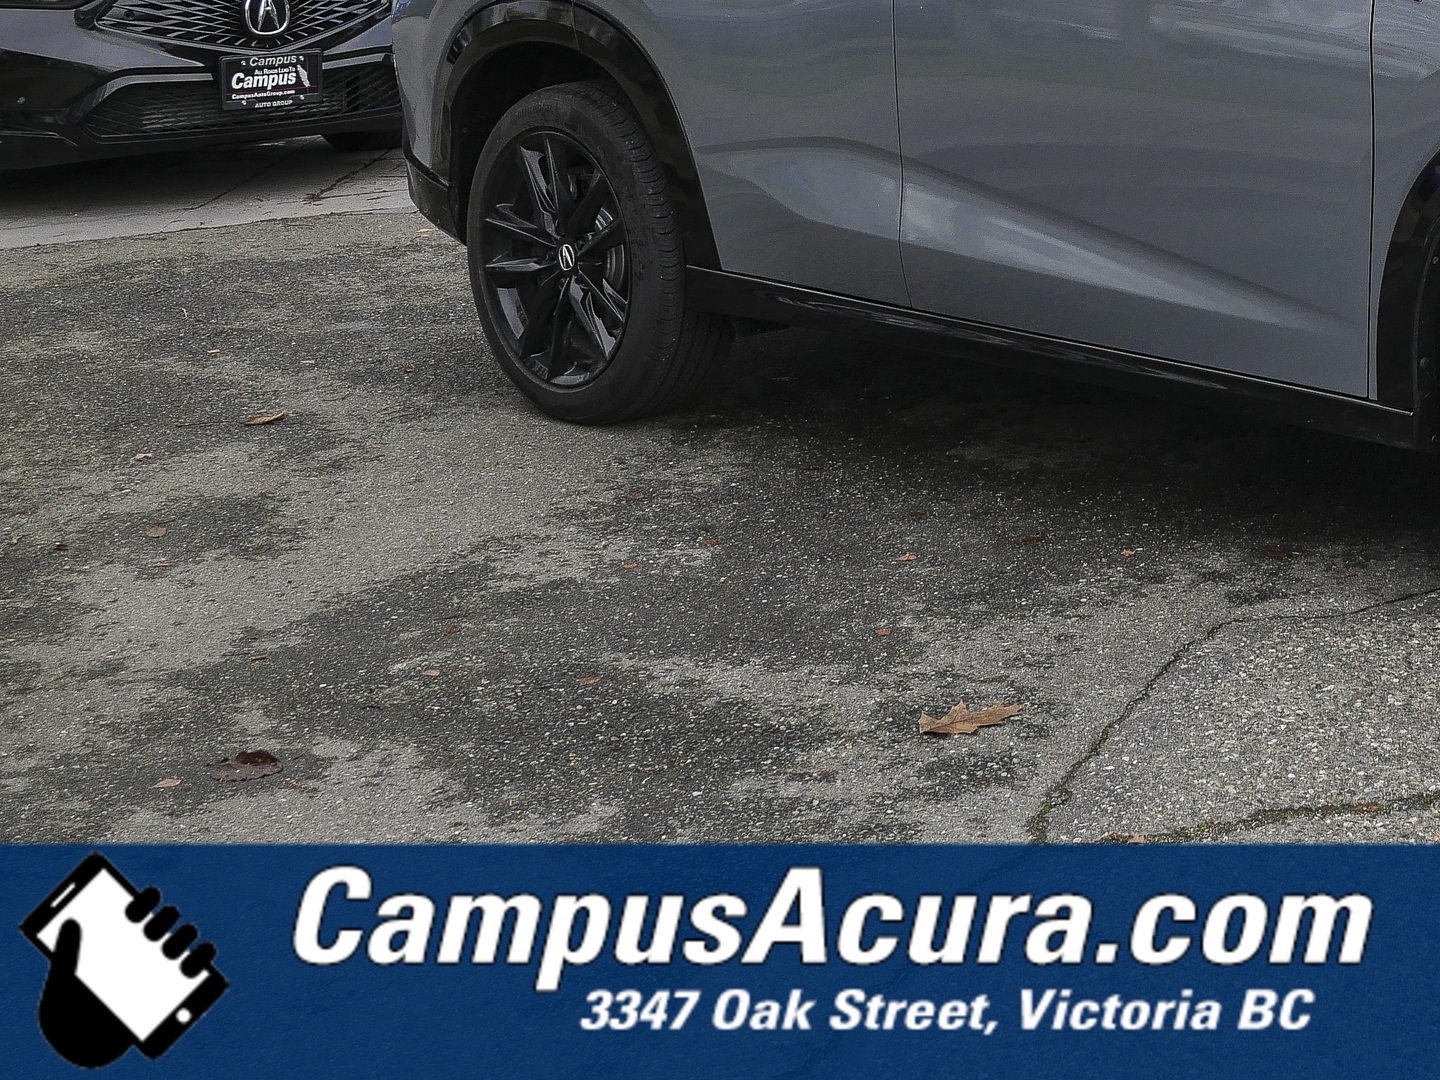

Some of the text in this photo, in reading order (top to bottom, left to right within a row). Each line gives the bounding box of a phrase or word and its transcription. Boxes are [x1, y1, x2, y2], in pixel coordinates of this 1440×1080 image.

[249, 56, 297, 67] Campus
[231, 72, 297, 90] Campus
[231, 90, 296, 99] CampusAutoGroup.com
